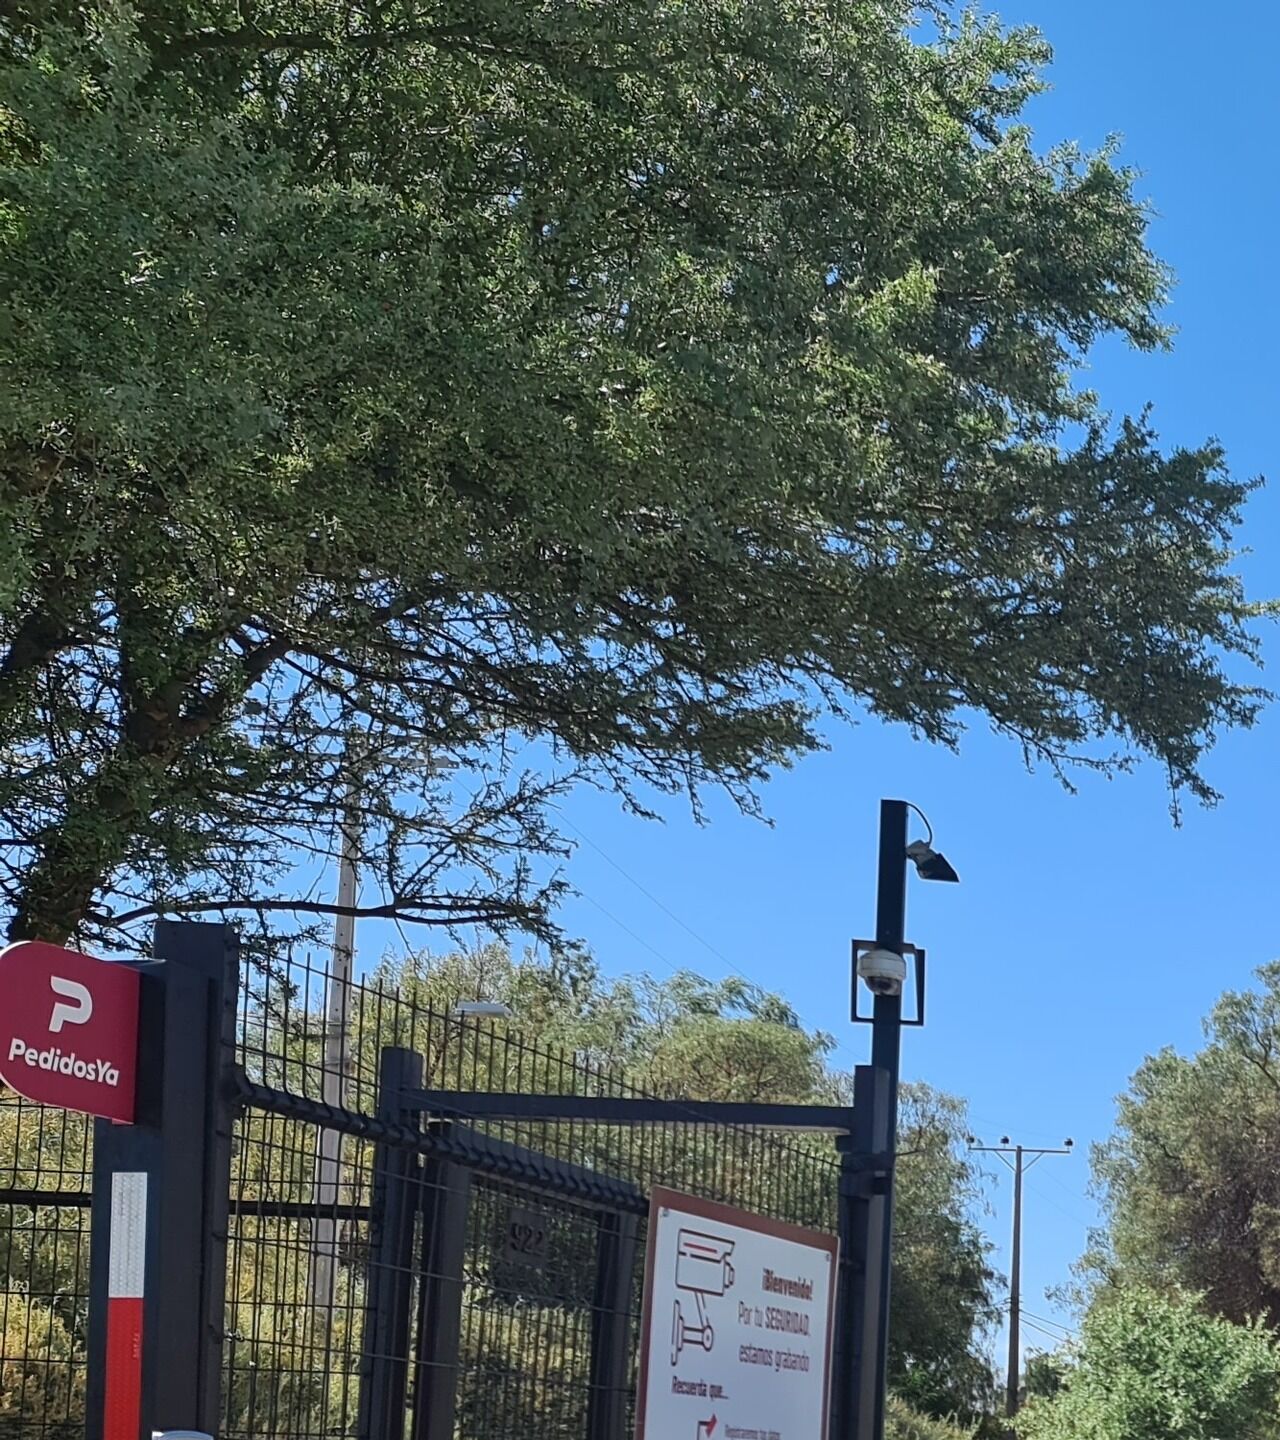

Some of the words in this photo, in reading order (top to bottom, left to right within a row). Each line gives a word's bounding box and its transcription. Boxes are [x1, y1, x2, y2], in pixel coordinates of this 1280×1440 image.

[8, 1038, 119, 1086] PedidosYa
[738, 1300, 752, 1325] Por
[754, 1306, 763, 1328] tu
[739, 1342, 773, 1367] estamos
[775, 1347, 809, 1373] grabando
[672, 1375, 707, 1397] Recuerda
